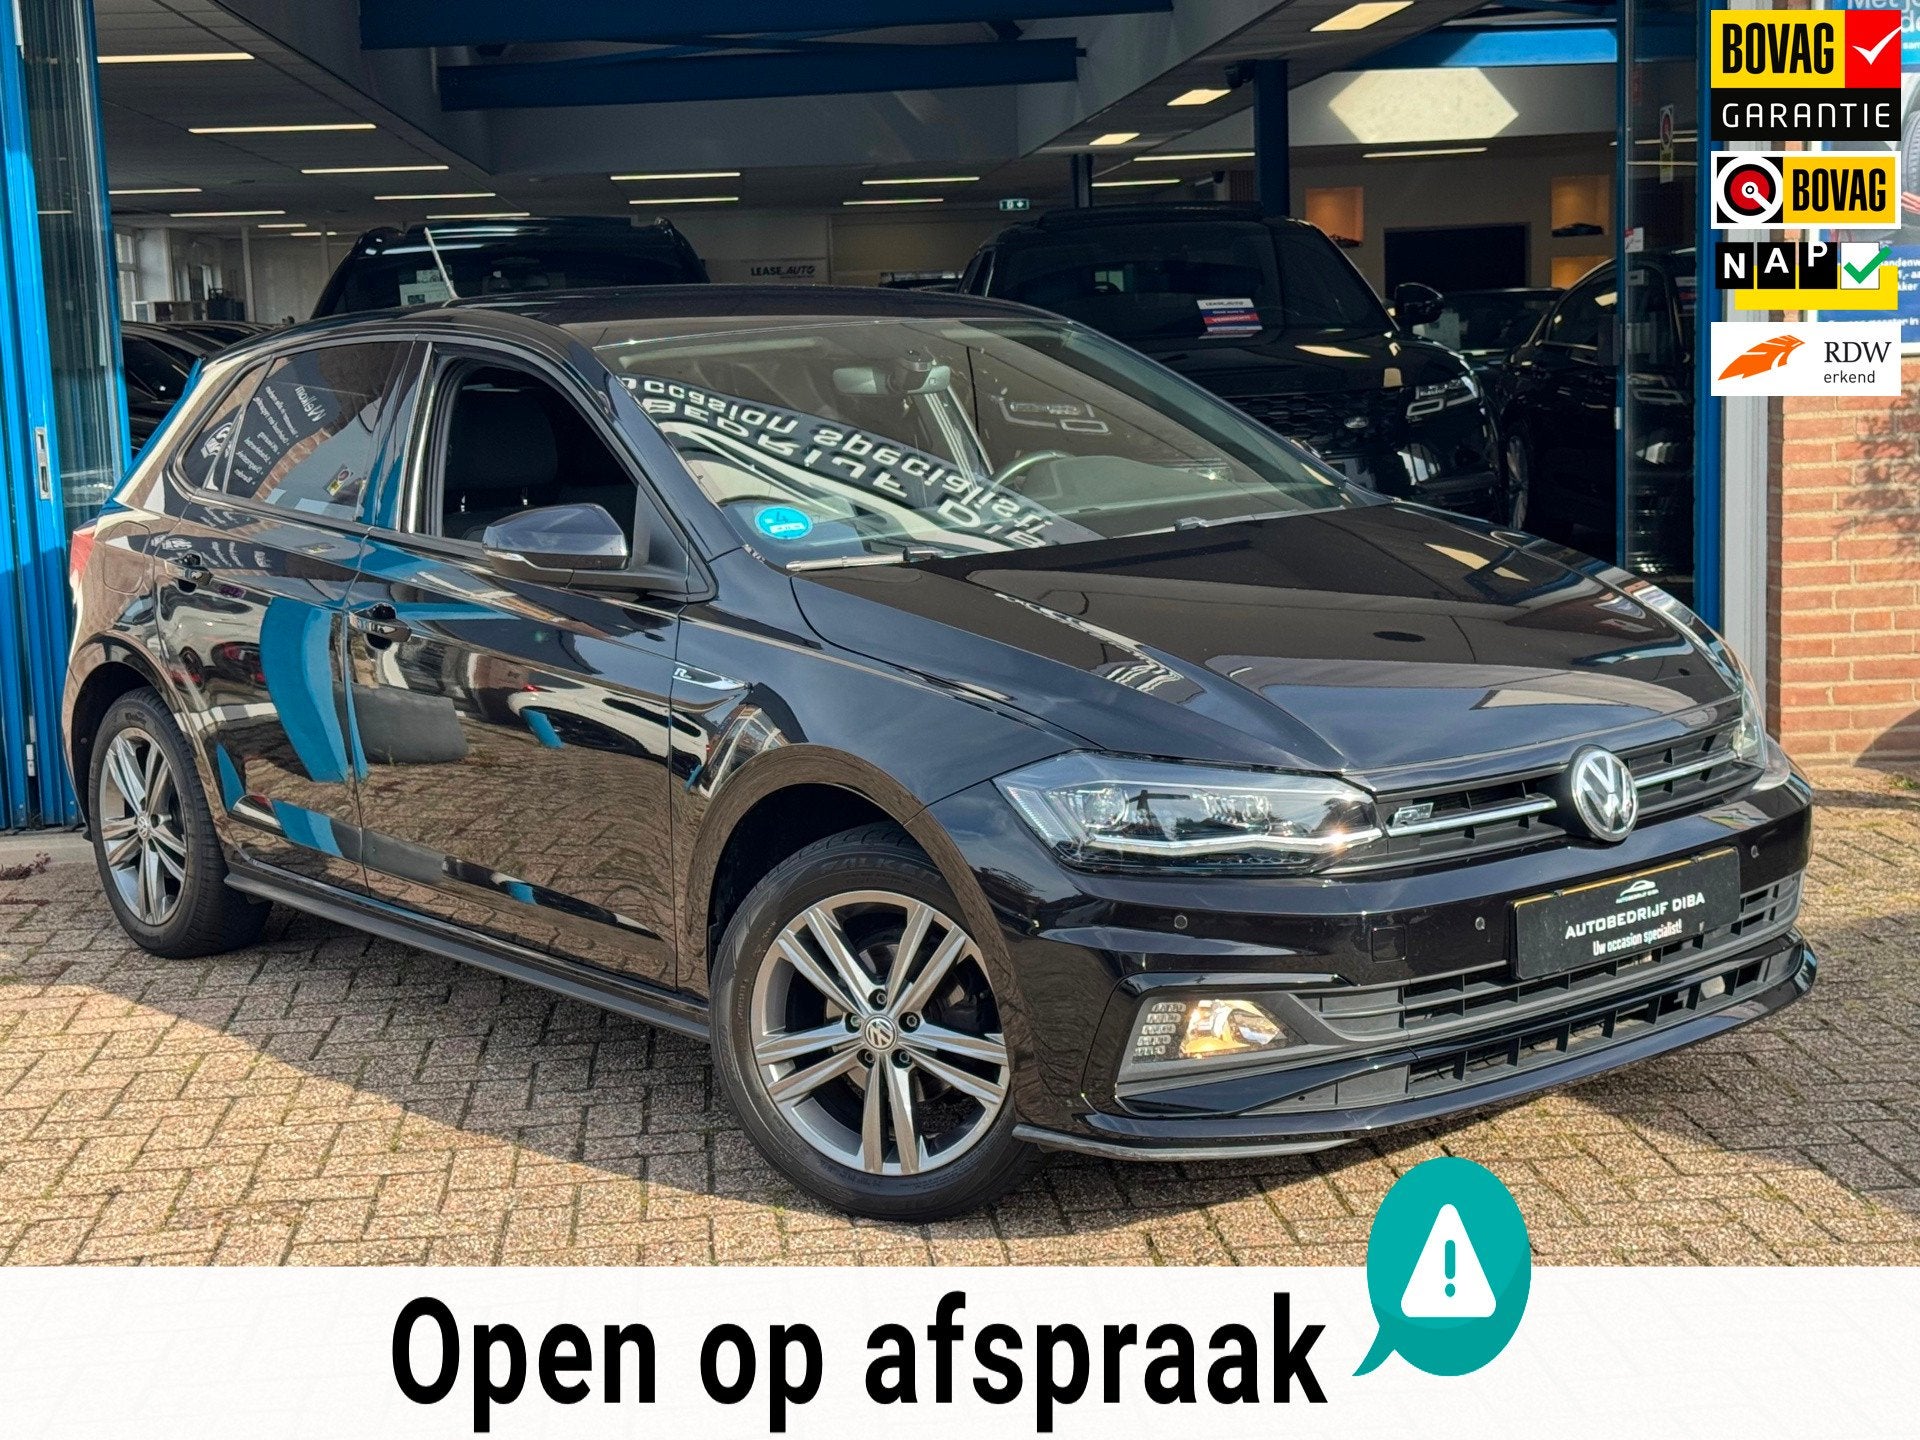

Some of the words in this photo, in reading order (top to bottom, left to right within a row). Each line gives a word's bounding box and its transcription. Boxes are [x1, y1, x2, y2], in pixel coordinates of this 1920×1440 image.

[1565, 901, 1668, 939] AUTOBEDRIJF
[1672, 892, 1705, 912] DIBA
[1593, 940, 1606, 956] Uw
[1607, 932, 1643, 953] occasion
[1643, 918, 1683, 944] specialist!
